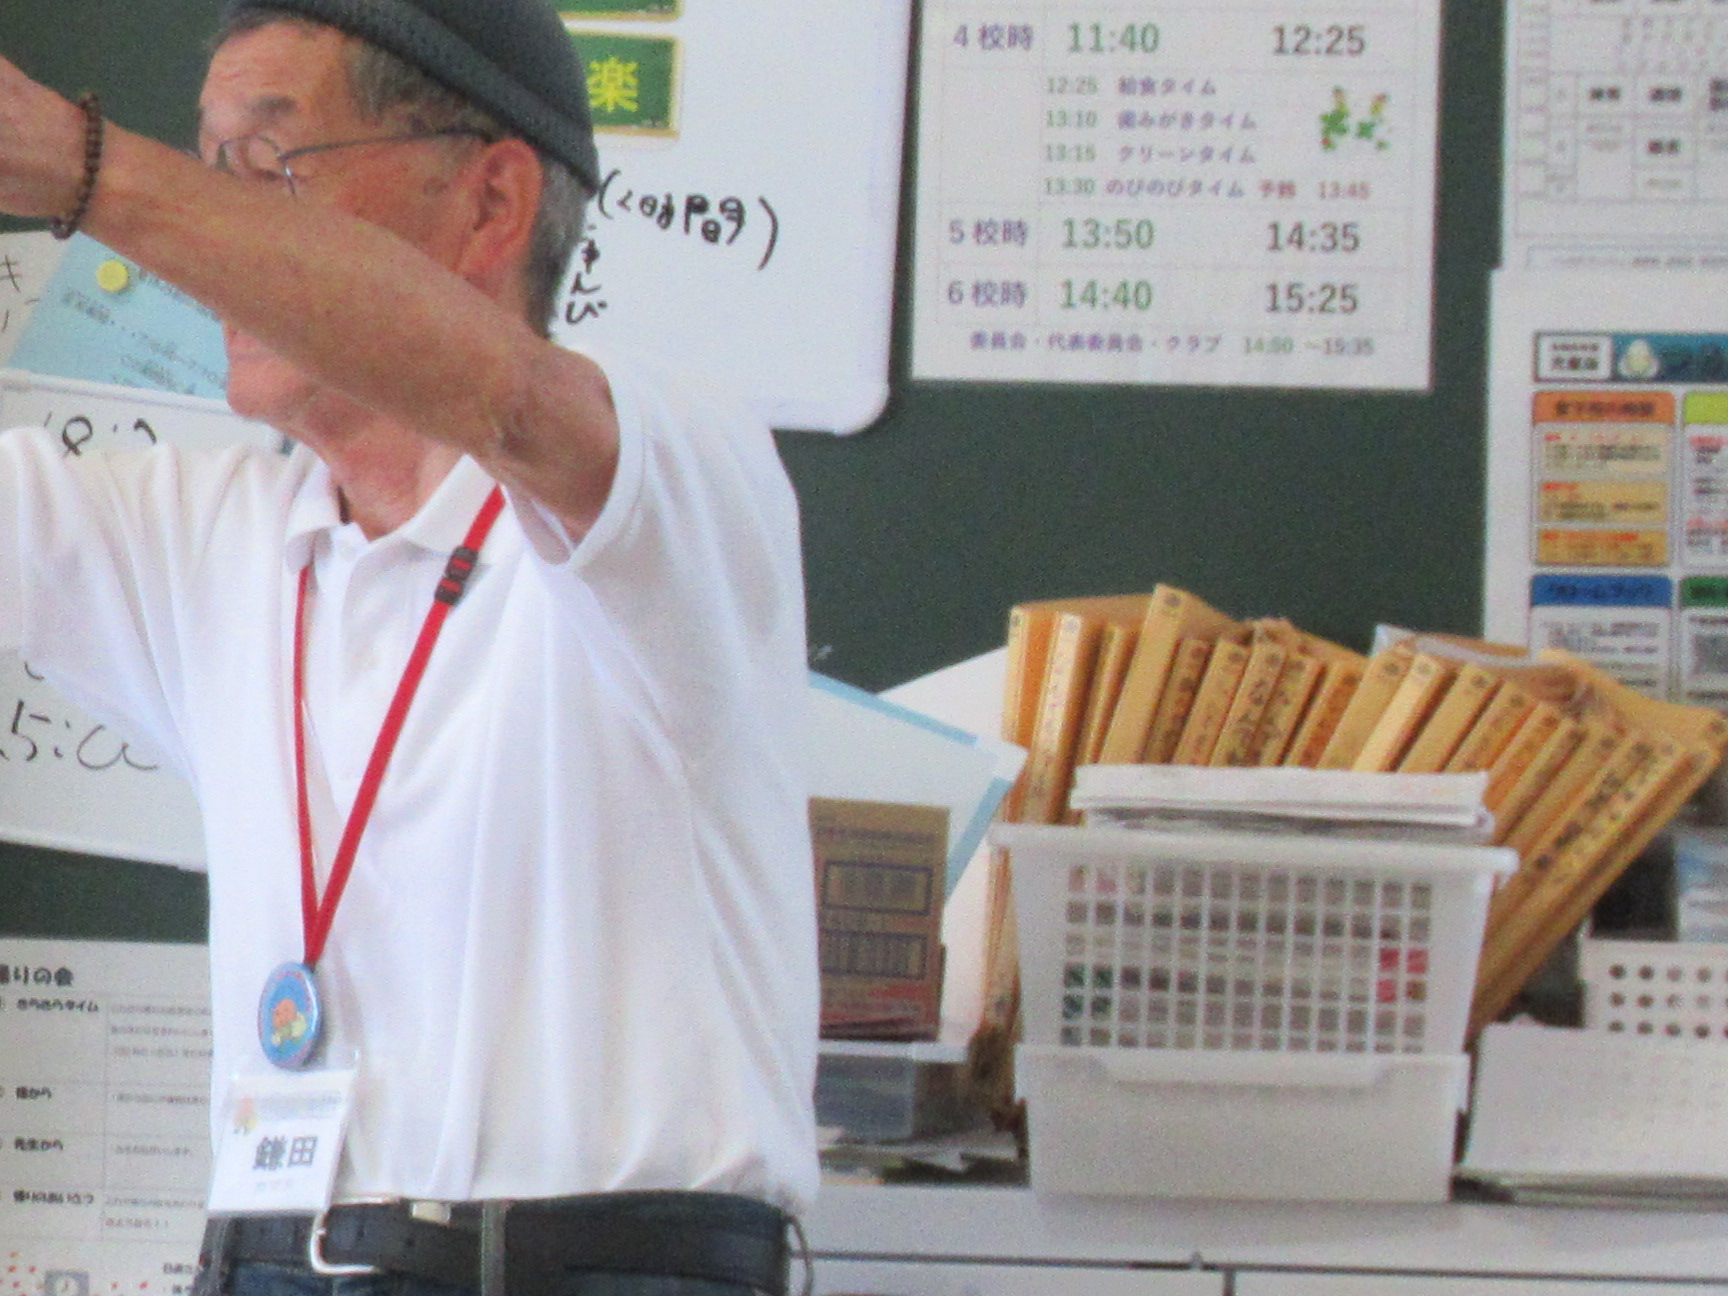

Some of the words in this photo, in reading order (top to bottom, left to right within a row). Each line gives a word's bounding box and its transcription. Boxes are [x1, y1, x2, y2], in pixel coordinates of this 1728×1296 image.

[1067, 23, 1160, 54] 11:40
[1273, 24, 1366, 56] 12:25
[1062, 219, 1155, 250] 13:50
[1267, 221, 1361, 253] 14:35
[1059, 280, 1153, 310] 14:40
[1266, 283, 1359, 315] 15:25
